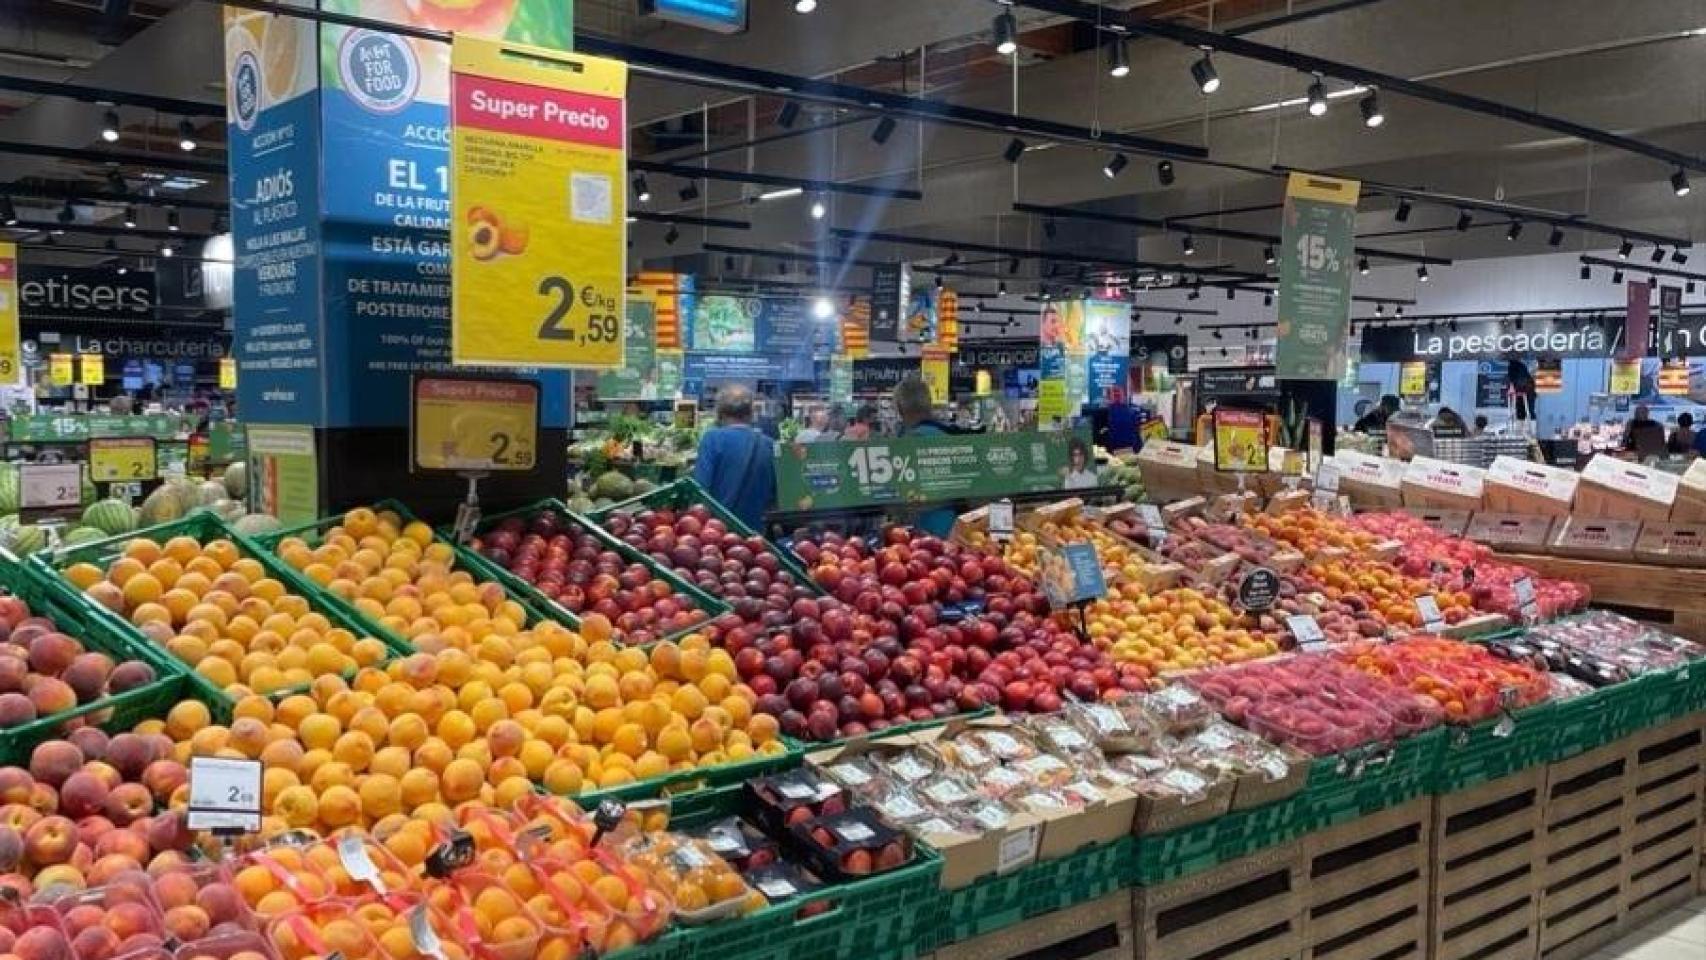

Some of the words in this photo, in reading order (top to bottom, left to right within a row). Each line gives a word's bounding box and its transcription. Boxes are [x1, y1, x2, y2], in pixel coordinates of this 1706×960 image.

[364, 59, 393, 77] FOR
[365, 75, 402, 93] FOOD
[471, 90, 539, 119] Super
[544, 102, 610, 130] Precio
[256, 168, 293, 202] ADIÓS
[389, 160, 427, 191] EL
[375, 192, 394, 206] DE
[397, 194, 415, 209] LA
[372, 236, 414, 255] ESTÁ
[20, 274, 150, 312] etisers
[348, 278, 370, 293] DE
[76, 335, 101, 354] La
[1414, 332, 1443, 355] La
[1448, 325, 1604, 359] pescadería
